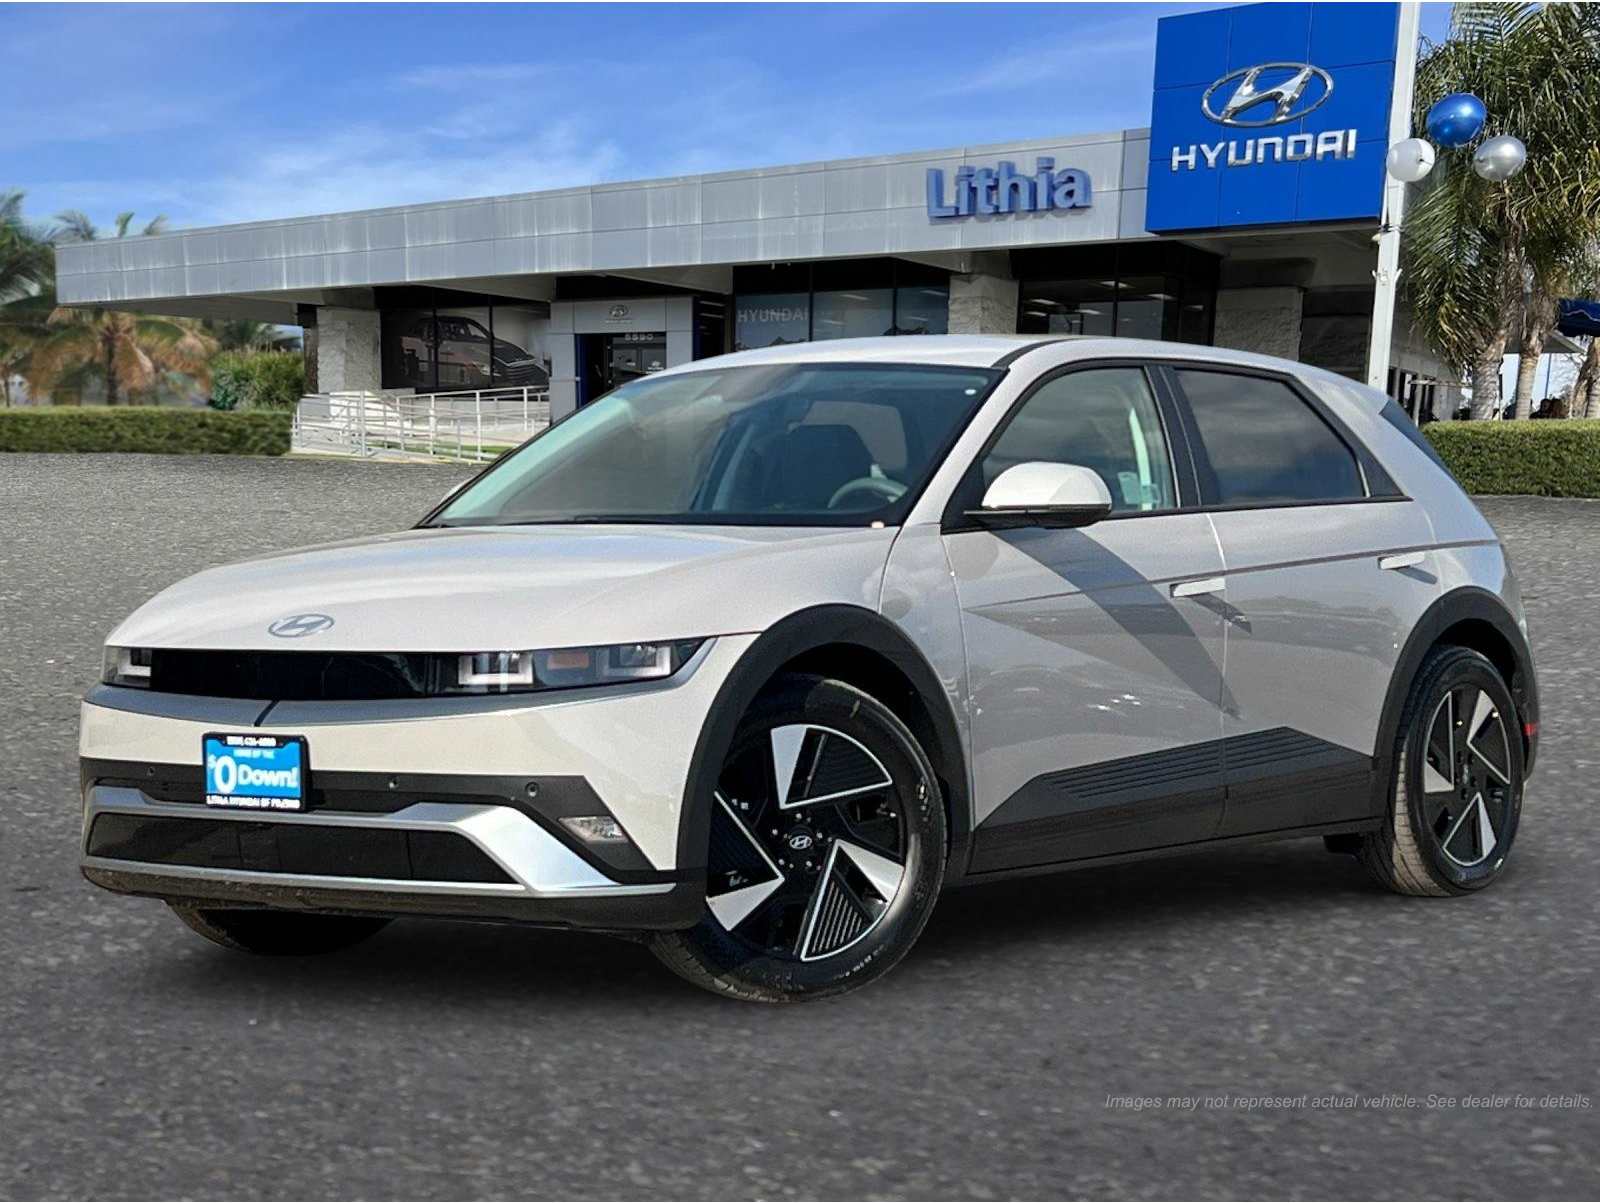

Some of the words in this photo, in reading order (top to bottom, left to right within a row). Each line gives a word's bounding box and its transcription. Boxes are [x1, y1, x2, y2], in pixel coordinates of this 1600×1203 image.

[1171, 129, 1357, 171] HYUNDAI
[926, 157, 1092, 218] Lithia
[737, 307, 809, 322] HYUNDAI
